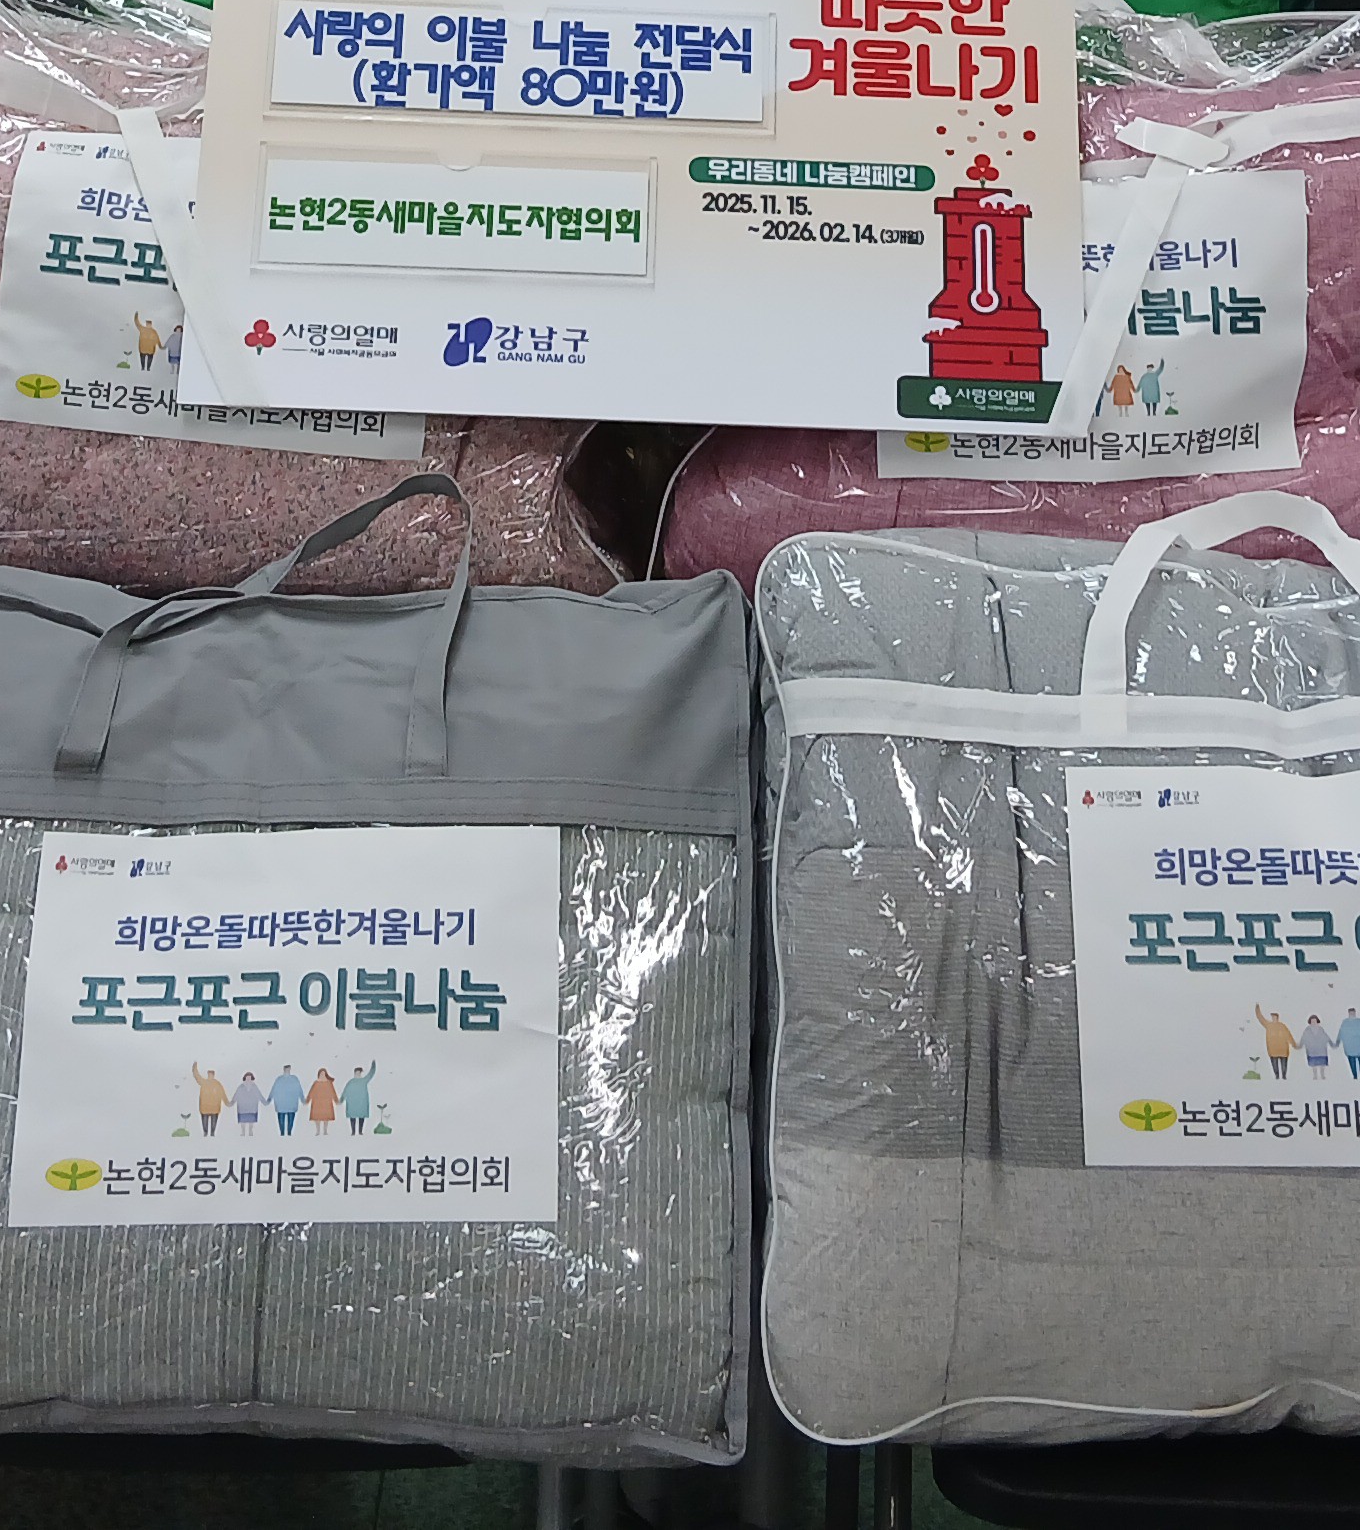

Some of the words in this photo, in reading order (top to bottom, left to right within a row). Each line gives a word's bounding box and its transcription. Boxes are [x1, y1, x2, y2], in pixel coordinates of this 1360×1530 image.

[284, 8, 405, 60] 사랑의
[426, 14, 508, 64] 이불
[532, 19, 610, 68] 나눔
[633, 22, 752, 74] 전달식
[352, 58, 496, 111] (환가액
[520, 67, 684, 118] 80만원)
[788, 38, 1039, 104] 겨울나기
[707, 158, 798, 184] 우리동네
[803, 161, 918, 190] 나눔캠페인
[269, 197, 640, 243] 논현2동새마을지도자협의회
[703, 192, 757, 213] 2025.
[760, 195, 781, 214] 11.
[787, 196, 812, 215] 15.
[818, 220, 852, 245] 02.
[851, 223, 879, 246] 14.
[282, 322, 399, 348] 사랑의열매
[494, 325, 590, 352] 강남구
[498, 352, 532, 362] GANG
[537, 354, 563, 362] NAM
[568, 355, 585, 364] GU
[953, 385, 1038, 407] 사랑의열매
[115, 909, 474, 951] 희망온돌따뜻한겨울나기
[1125, 911, 1343, 972] 포근포근
[72, 972, 287, 1031] 포근포근
[300, 968, 507, 1034] 이불나눔
[103, 1156, 509, 1195] 논현2동새마을지도자협의회
